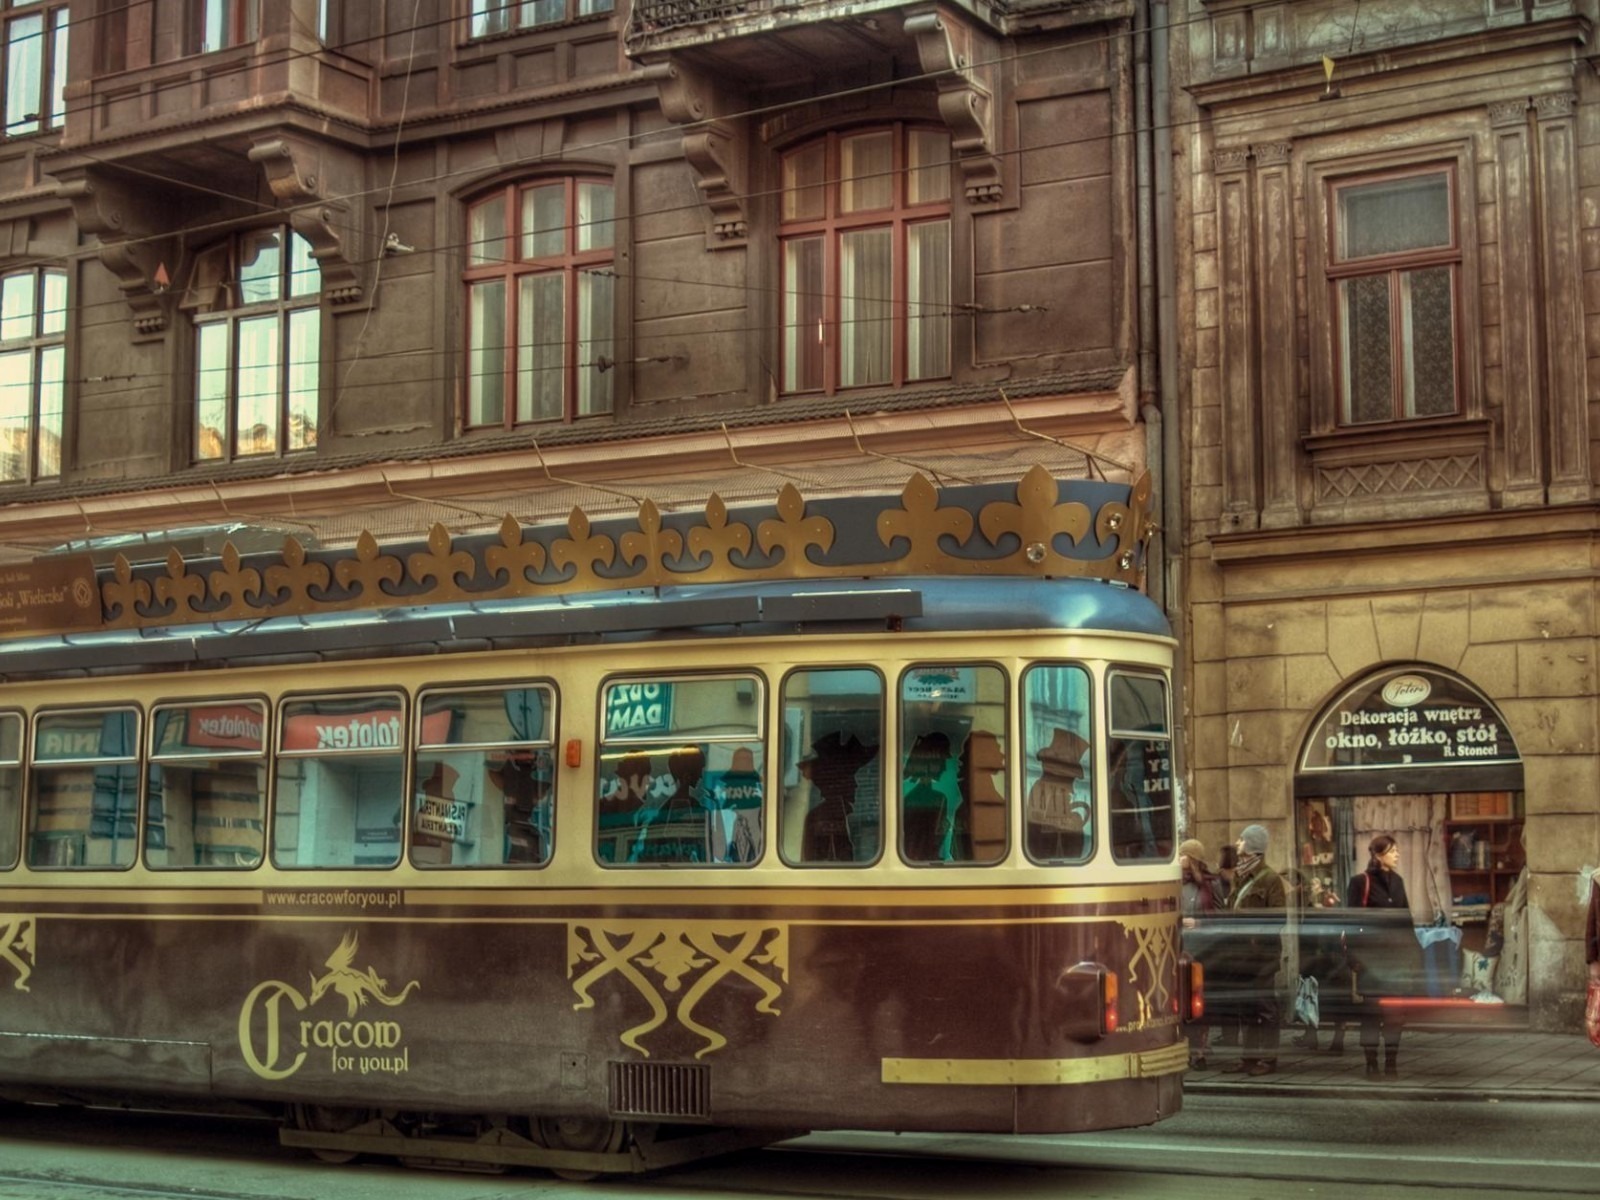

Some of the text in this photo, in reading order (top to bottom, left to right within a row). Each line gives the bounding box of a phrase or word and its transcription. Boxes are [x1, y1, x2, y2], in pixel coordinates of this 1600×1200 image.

[1340, 706, 1482, 726] Dekoracja wnętrz
[1326, 723, 1498, 749] okno, łóżko, stół
[1443, 746, 1456, 757] R.
[267, 889, 401, 908] www.cracowforyou.pl
[238, 979, 402, 1080] Cracow
[332, 1046, 409, 1075] for you.pl
